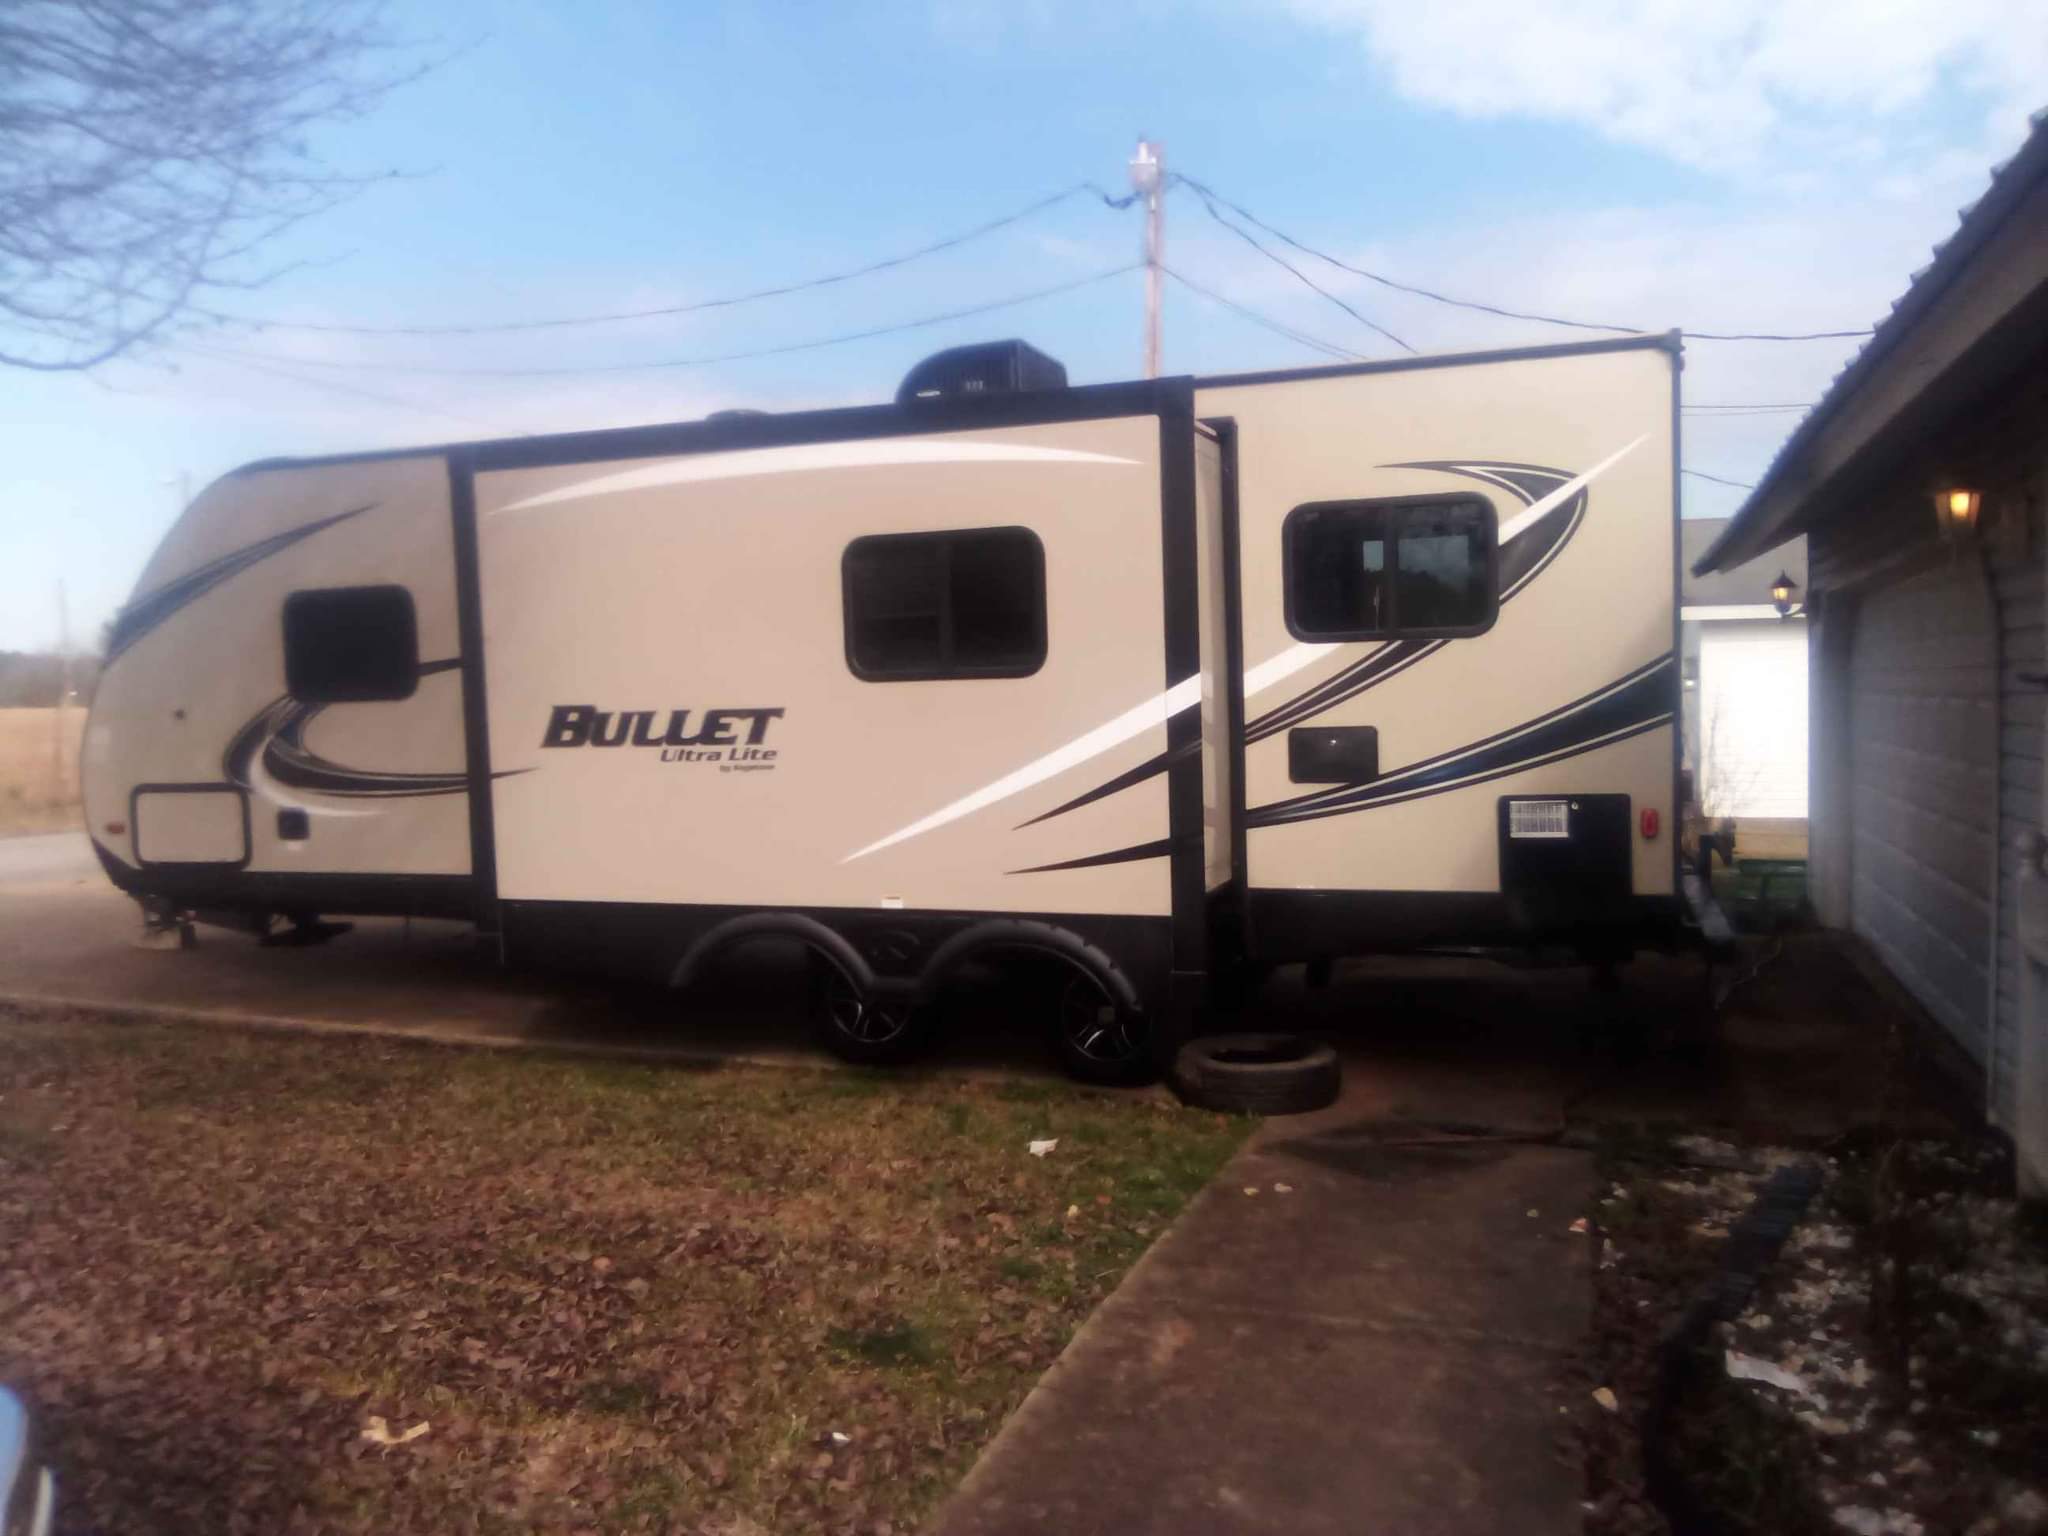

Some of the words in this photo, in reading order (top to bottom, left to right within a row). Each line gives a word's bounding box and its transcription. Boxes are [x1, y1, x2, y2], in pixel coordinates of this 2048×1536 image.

[540, 705, 785, 748] BULLET
[660, 749, 722, 762] Ultra
[728, 747, 777, 761] Lite
